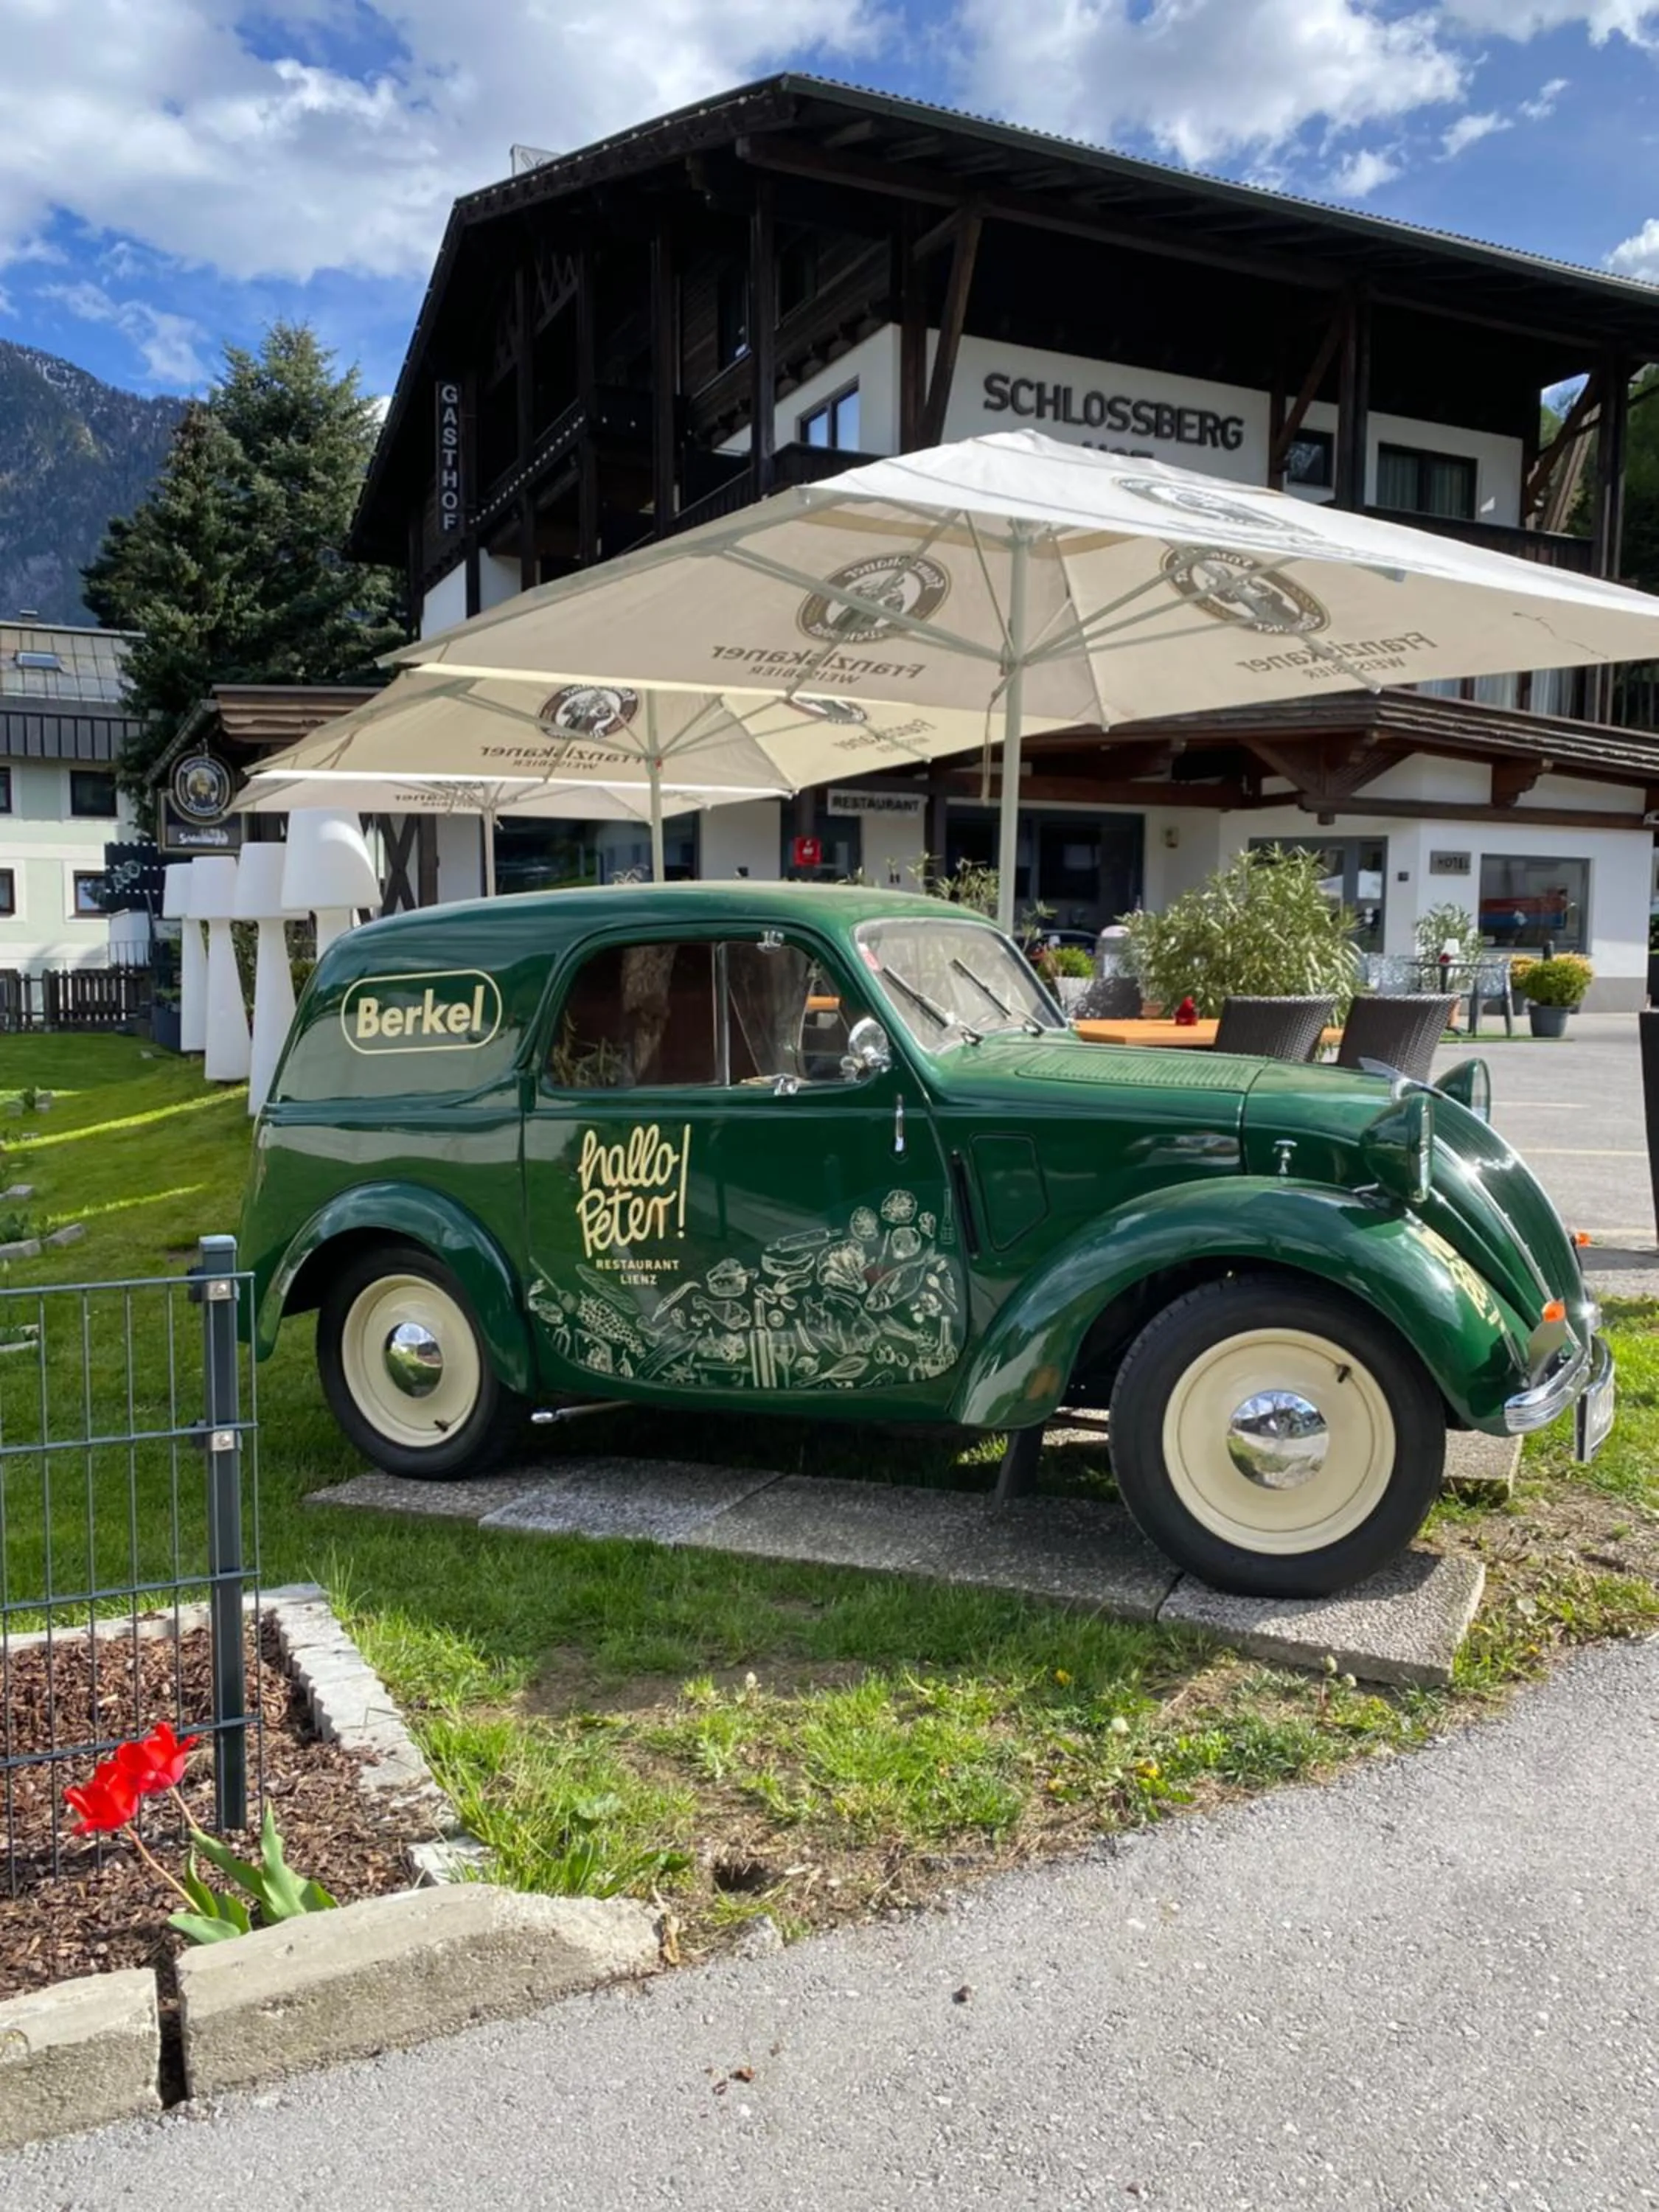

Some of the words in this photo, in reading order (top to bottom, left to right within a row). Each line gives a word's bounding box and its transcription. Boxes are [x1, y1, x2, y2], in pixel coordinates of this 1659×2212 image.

[984, 372, 1244, 450] SCHLOSSBERG
[441, 385, 458, 530] GASTHOF
[832, 796, 920, 813] RESTAURANT
[356, 985, 485, 1038] Berkel
[596, 1259, 679, 1270] RESTAURANT
[620, 1274, 658, 1285] LIENZ
